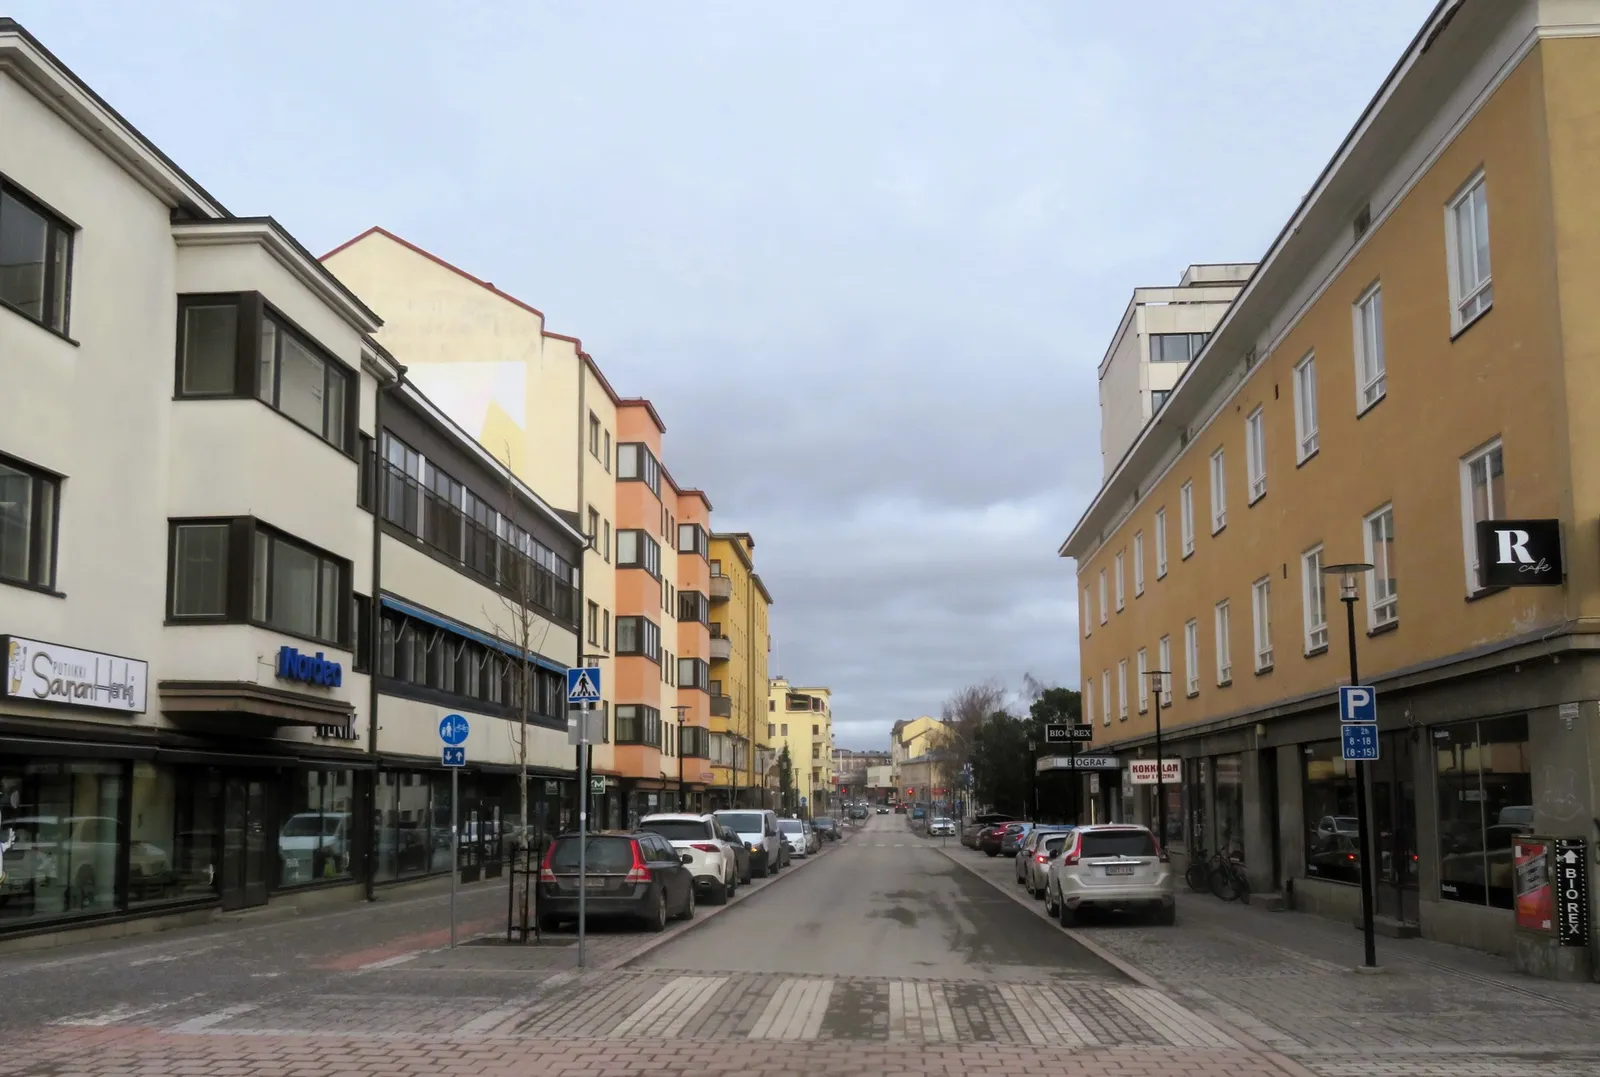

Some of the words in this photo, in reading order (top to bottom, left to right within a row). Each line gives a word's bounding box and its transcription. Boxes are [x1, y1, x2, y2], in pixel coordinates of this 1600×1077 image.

[1494, 529, 1536, 564] R
[53, 661, 87, 679] PUTIIKKI
[279, 646, 342, 687] Nordea
[1346, 689, 1370, 719] P
[1049, 729, 1065, 737] BIO
[1073, 729, 1091, 737] REX
[1360, 727, 1370, 735] 2h
[1565, 868, 1579, 900] BIO
[1567, 902, 1580, 935] REX
